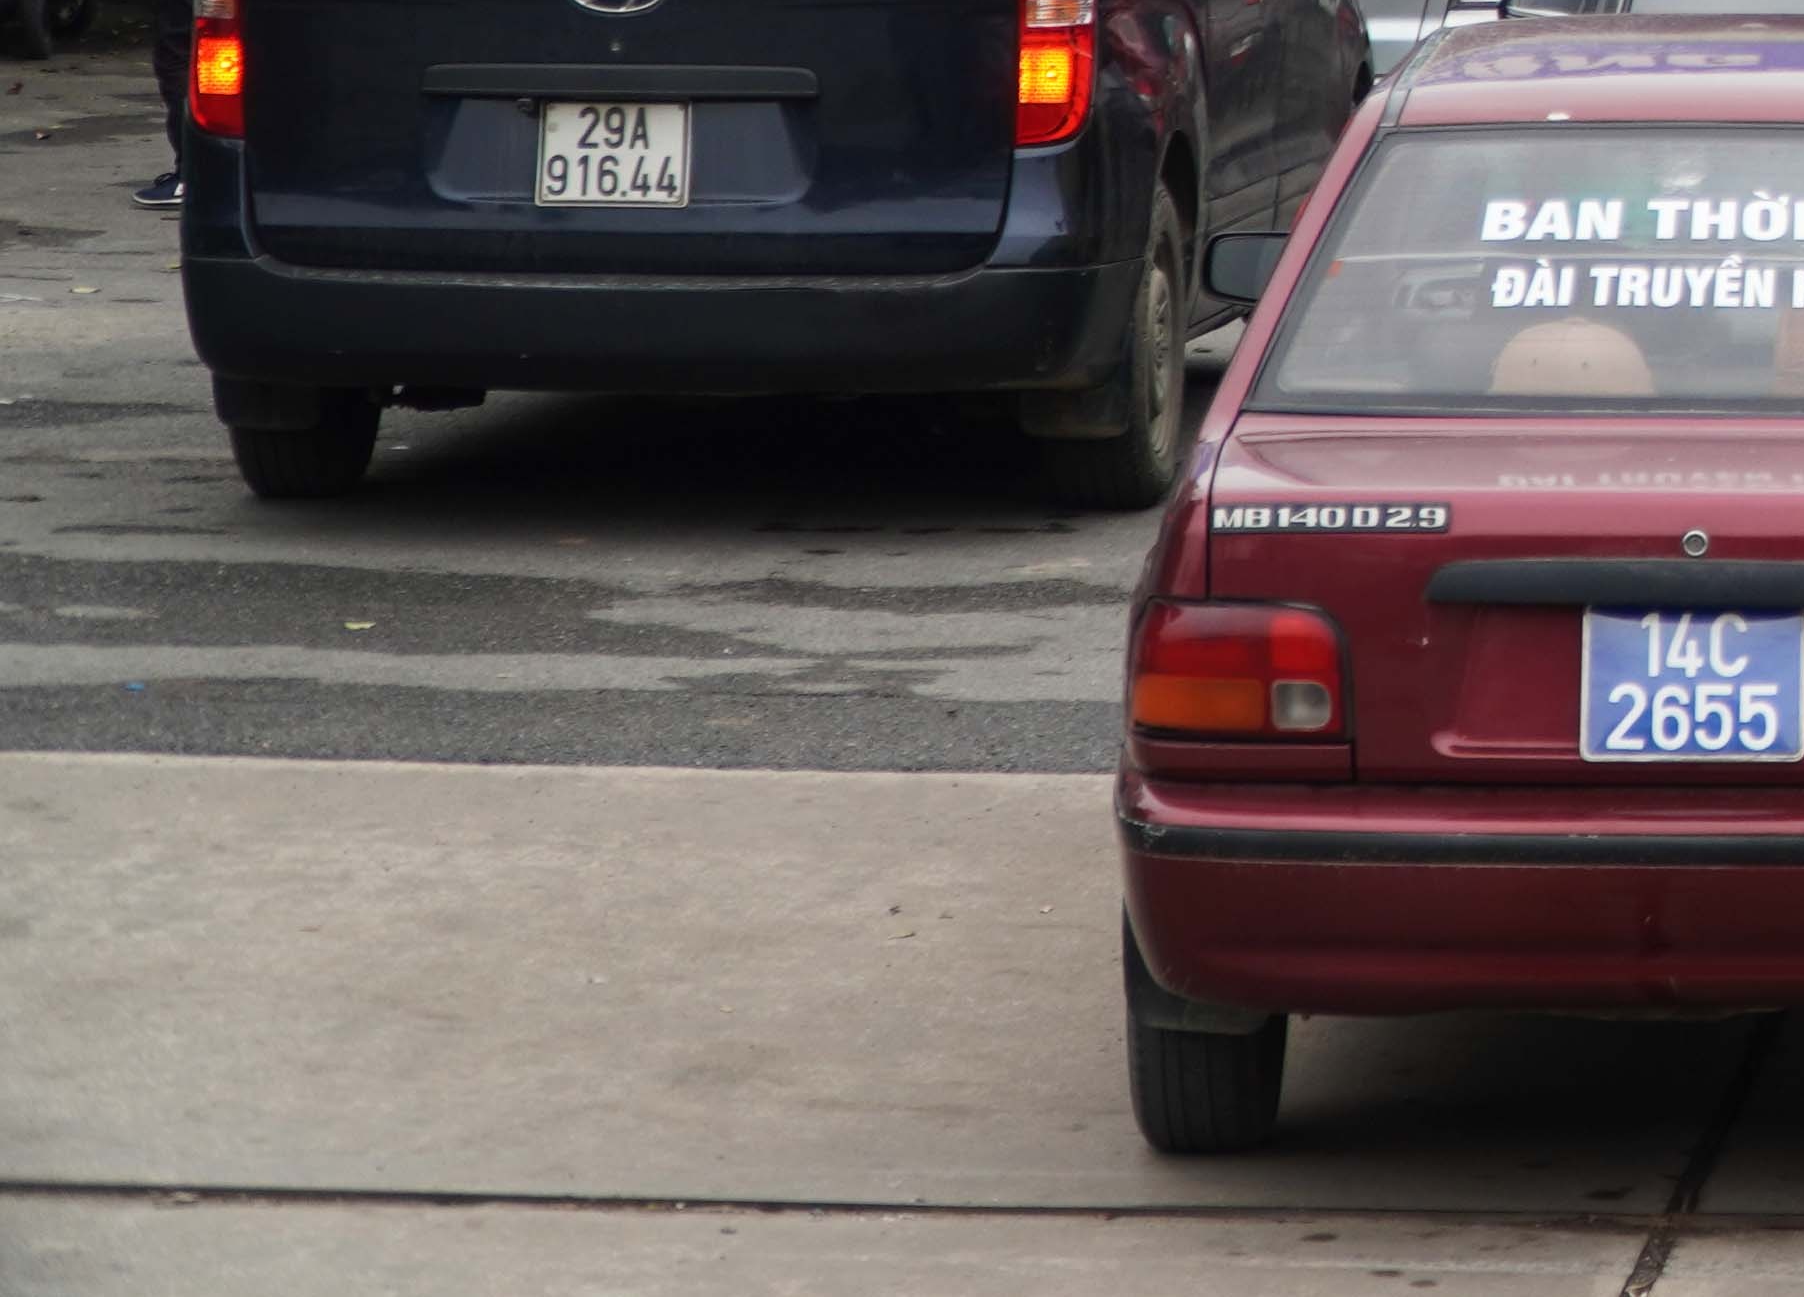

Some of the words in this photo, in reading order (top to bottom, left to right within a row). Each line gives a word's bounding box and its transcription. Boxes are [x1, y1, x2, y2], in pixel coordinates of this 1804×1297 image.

[576, 106, 650, 150] 29A
[545, 154, 678, 198] 916.44
[1480, 199, 1623, 242] BAN
[1489, 257, 1577, 308] ĐÀI
[1588, 254, 1776, 308] TRUYỀN
[1212, 506, 1271, 529] MB
[1277, 506, 1346, 529] 140
[1352, 506, 1380, 528] D
[1384, 506, 1447, 529] 2.9
[1641, 613, 1749, 678] 14C
[1605, 682, 1779, 751] 2655
